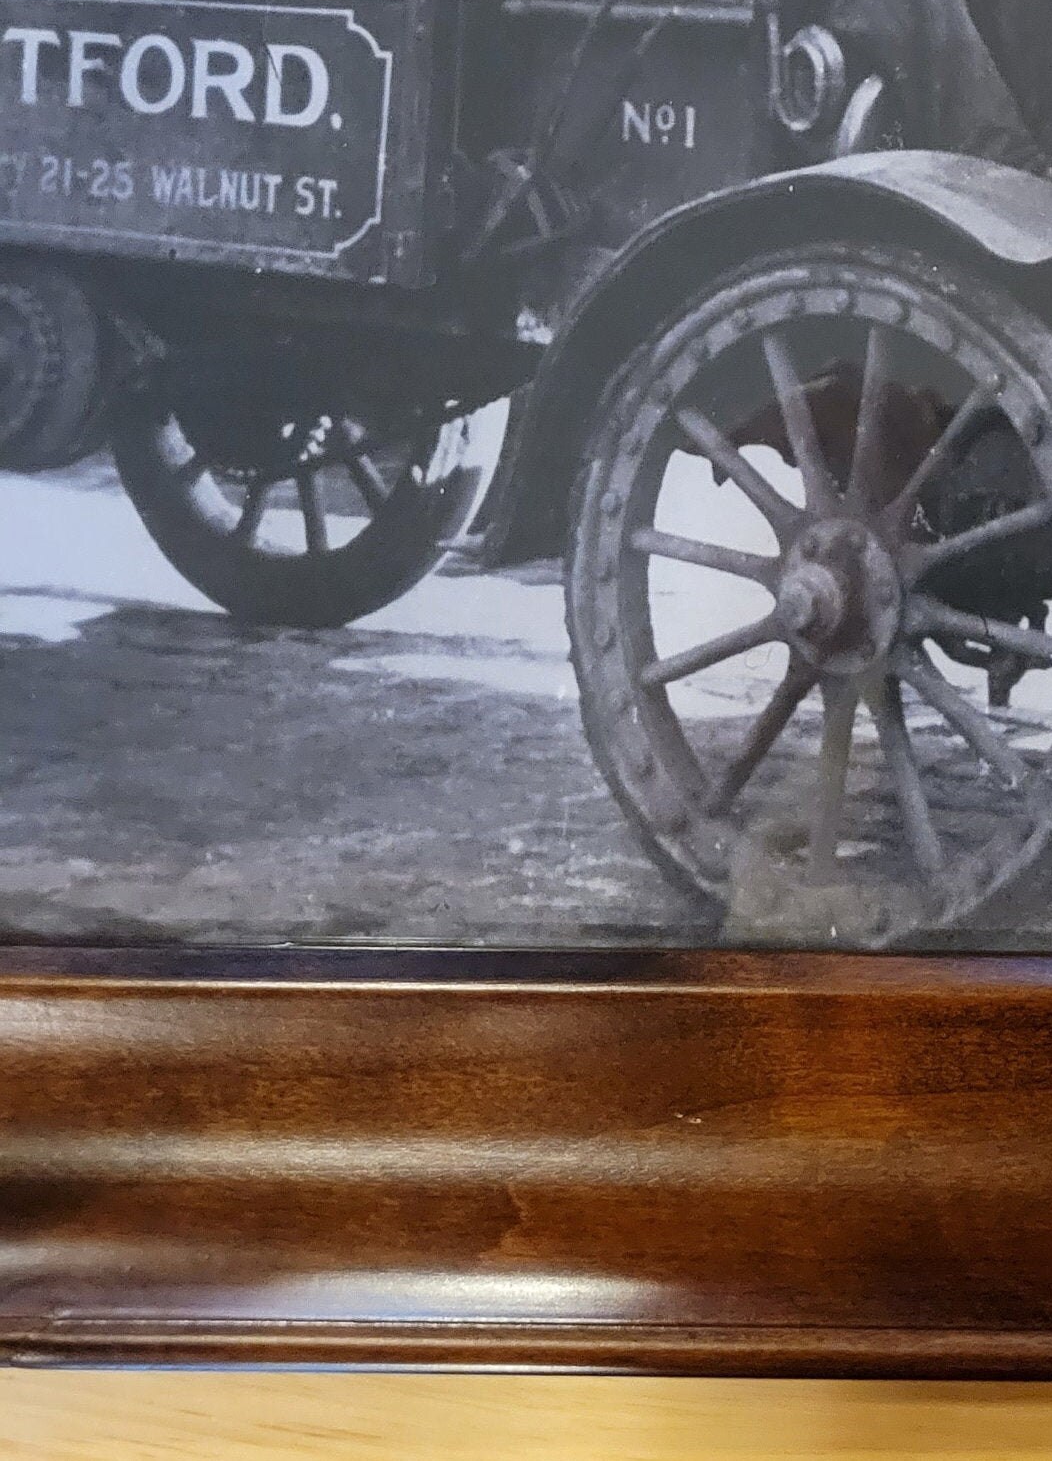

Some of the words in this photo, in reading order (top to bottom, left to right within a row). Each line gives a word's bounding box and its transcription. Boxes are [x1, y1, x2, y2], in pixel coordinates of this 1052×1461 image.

[40, 156, 134, 200] 21-25
[152, 164, 283, 213] WALNUT
[295, 176, 342, 219] ST.
